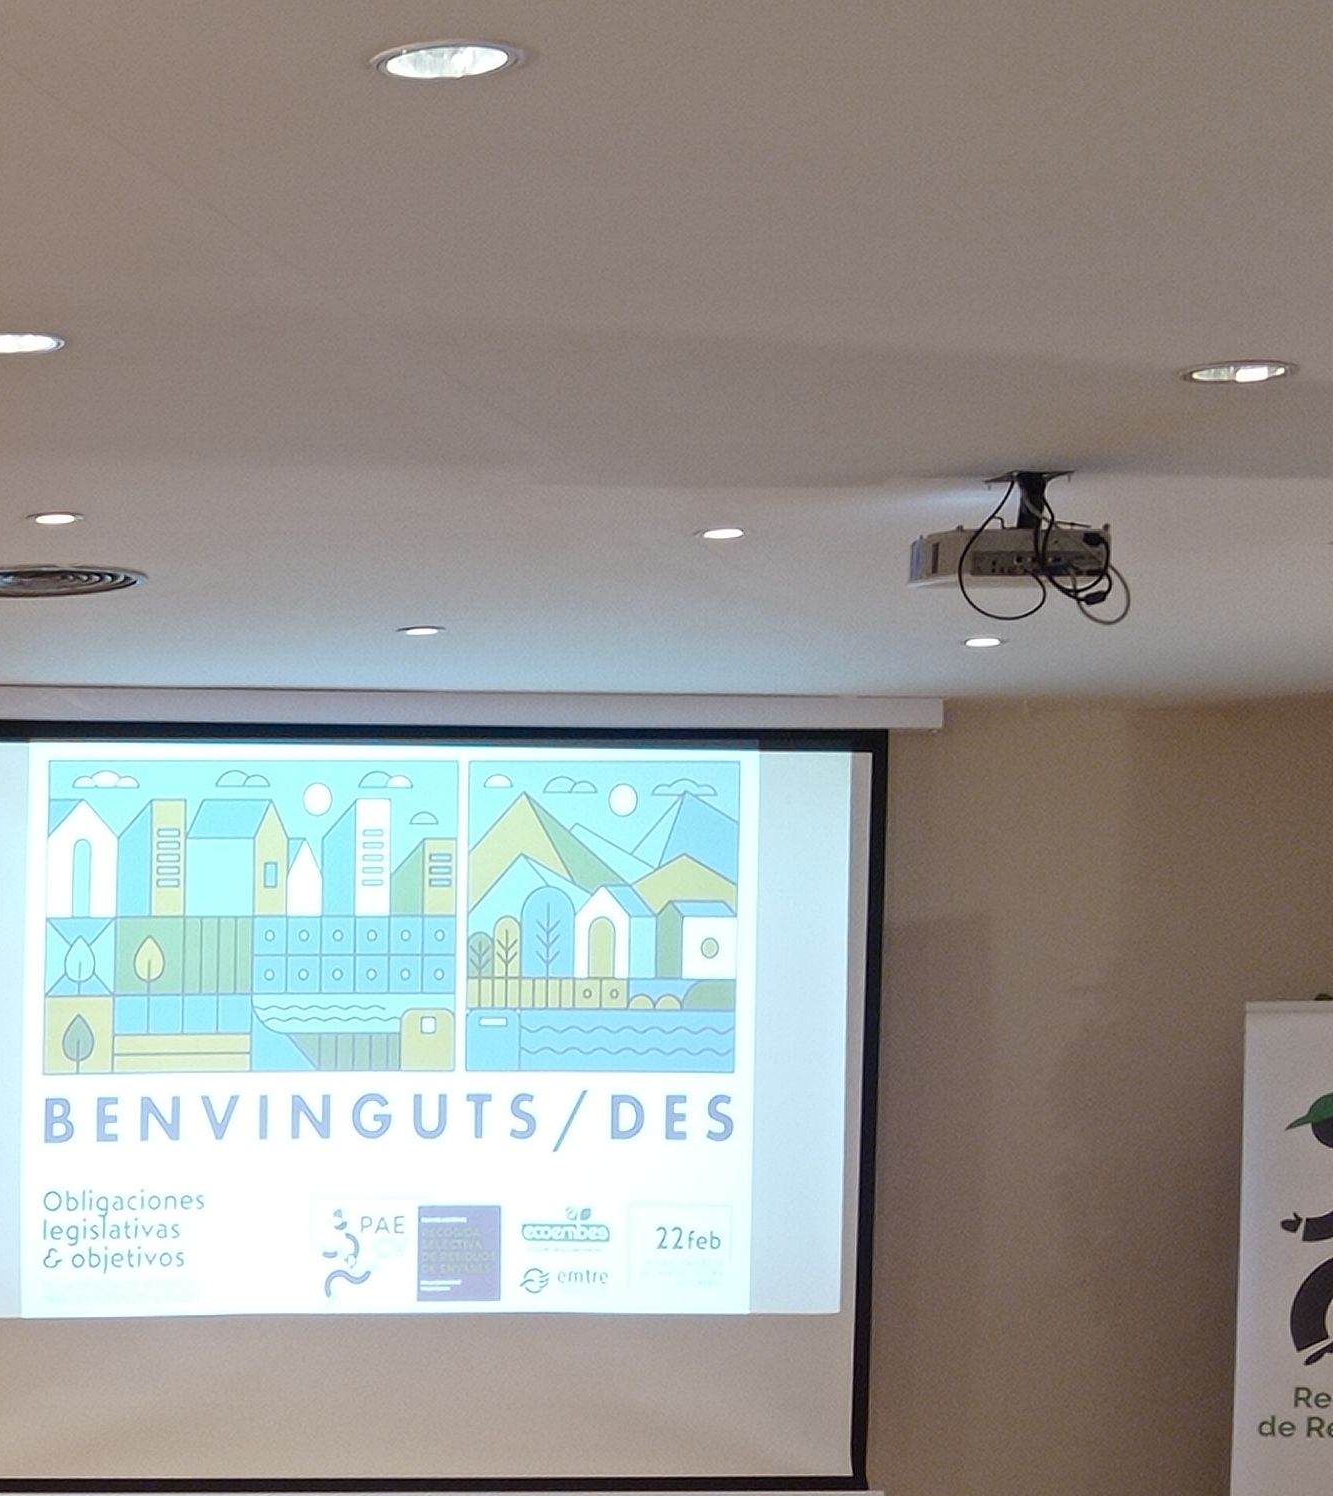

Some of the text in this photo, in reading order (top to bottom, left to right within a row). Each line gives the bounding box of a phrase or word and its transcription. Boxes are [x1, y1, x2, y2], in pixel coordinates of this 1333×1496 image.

[44, 1090, 734, 1152] BENVINGUTS/DES
[43, 1189, 205, 1217] Obligaciones
[43, 1215, 181, 1246] legislativas
[360, 1215, 406, 1234] PAE
[524, 1226, 607, 1241] ecoembes
[656, 1226, 721, 1250] 22feb
[43, 1246, 185, 1274] & objetivos
[557, 1269, 609, 1285] emtre
[1258, 1414, 1296, 1437] de
